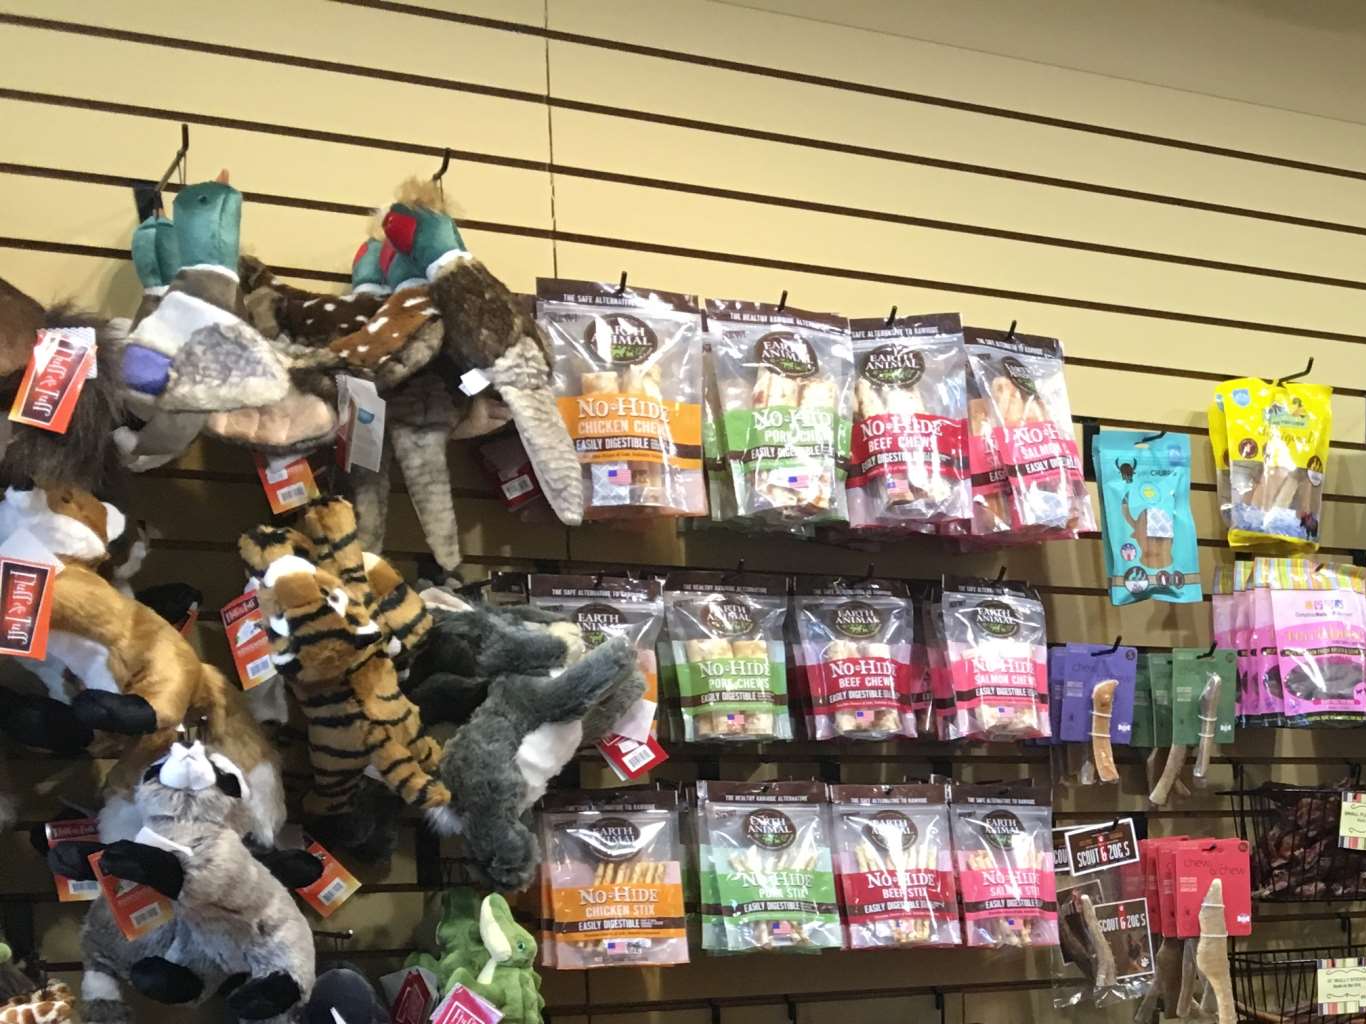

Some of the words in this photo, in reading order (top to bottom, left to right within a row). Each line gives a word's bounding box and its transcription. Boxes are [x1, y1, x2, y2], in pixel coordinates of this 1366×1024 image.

[578, 419, 628, 434] CHICKEN
[576, 438, 602, 450] EASILY
[605, 437, 649, 450] DIGESTIBLE
[868, 436, 893, 452] BEEF
[1025, 460, 1049, 473] EASILY
[578, 613, 619, 623] EARTH
[835, 616, 880, 625] ANIMAL
[839, 677, 861, 688] BEEF
[722, 692, 756, 701] DIGESTIBLE
[848, 690, 883, 700] DIGESTIBLE
[1077, 848, 1099, 867] SCOUT
[579, 886, 658, 905] NO-HIDE
[585, 906, 630, 917] CHICKEN
[633, 904, 655, 916] STIX
[744, 903, 767, 913] EASILY
[864, 903, 885, 913] EASILY
[579, 920, 602, 931] EASILY
[604, 919, 640, 929] DIGESTIBLE
[1099, 917, 1119, 932] SCOUT
